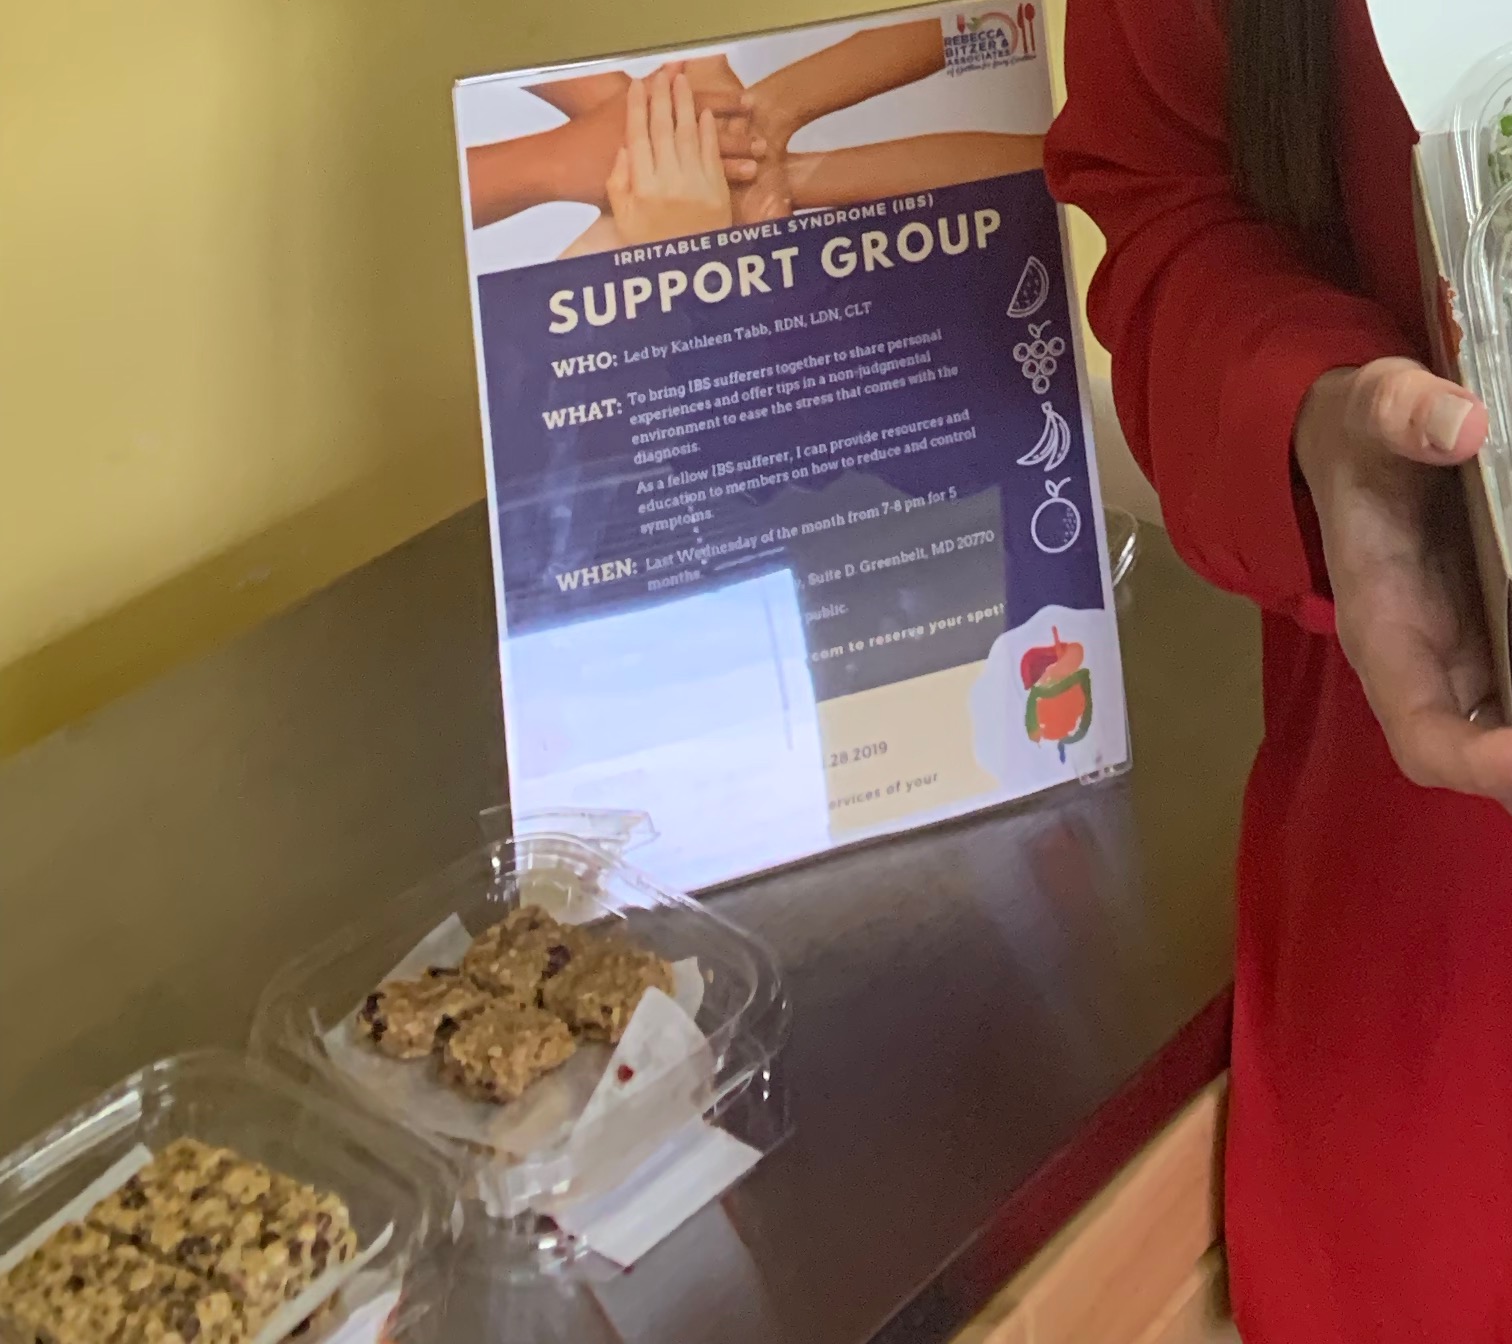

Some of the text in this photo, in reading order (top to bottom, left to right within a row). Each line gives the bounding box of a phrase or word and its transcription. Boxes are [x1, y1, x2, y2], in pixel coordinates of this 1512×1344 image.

[943, 27, 1005, 47] REBECCA
[945, 40, 997, 59] BITZER
[613, 192, 934, 267] IRRITABLE BOWEL SYNDROME (IBS)
[548, 208, 1002, 334] SUPPORT GROUP
[551, 301, 873, 379] WHO: Led by Kathleen Tabb, RDN, LDN, CLT
[542, 328, 943, 430] WHAT: To bring IBS sufferers together to share personal
[629, 350, 932, 426] experiences and offer tips in a non-judgmental
[631, 365, 960, 445] environment to ease the stress that comes with the
[633, 442, 701, 466] diagnosis.
[636, 409, 971, 495] As a fellow IBS sufferer, I can provide resources and
[637, 426, 978, 515] education to members on how to reduce and control
[555, 486, 958, 593] WHEN: Last Wednesday of the month from 7-8 pm for 5
[640, 509, 715, 536] symptoms.
[807, 567, 842, 587] Suite
[858, 547, 930, 575] Greenbelt,
[931, 538, 955, 557] MD
[956, 529, 996, 551] 20770
[848, 638, 866, 653] to
[869, 625, 926, 649] reserve
[928, 614, 964, 636] your
[852, 740, 889, 762] 2019
[827, 772, 939, 811] ervices of your
